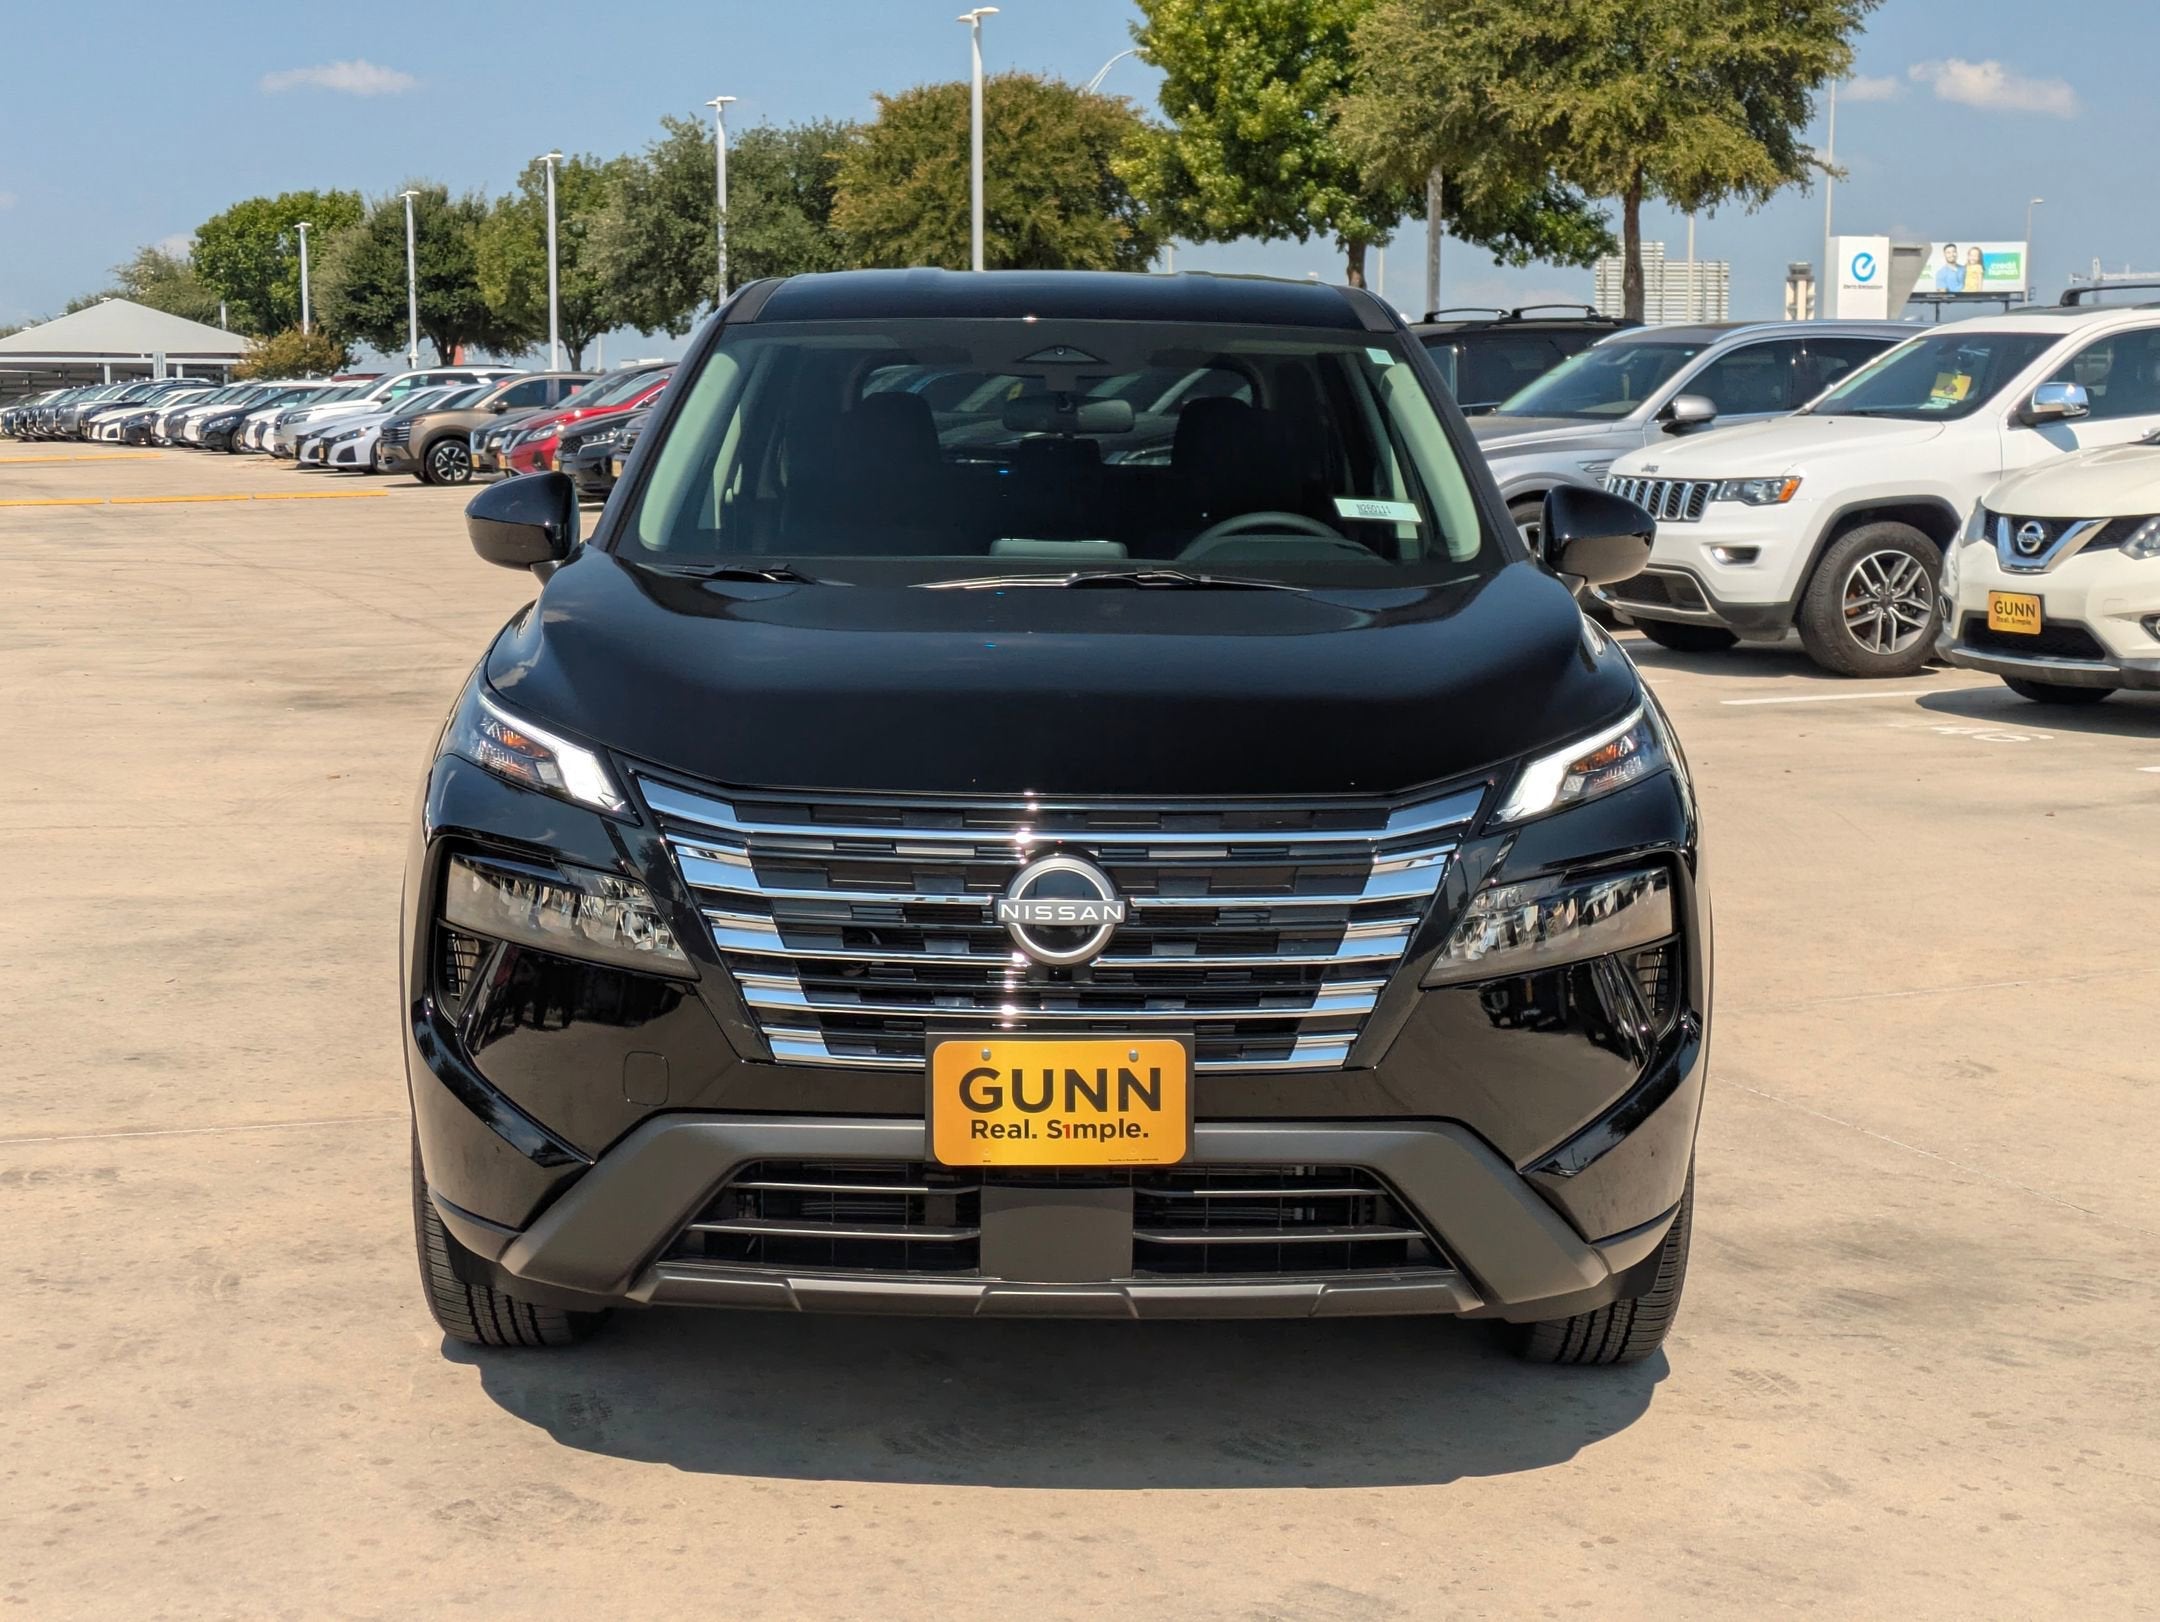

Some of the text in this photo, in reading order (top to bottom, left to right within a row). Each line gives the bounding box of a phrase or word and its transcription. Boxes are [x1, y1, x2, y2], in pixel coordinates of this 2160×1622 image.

[1994, 600, 2036, 618] GUNN
[1000, 905, 1121, 921] NISSAN
[958, 1067, 1161, 1113] GUNN
[971, 1119, 1038, 1139] Real.
